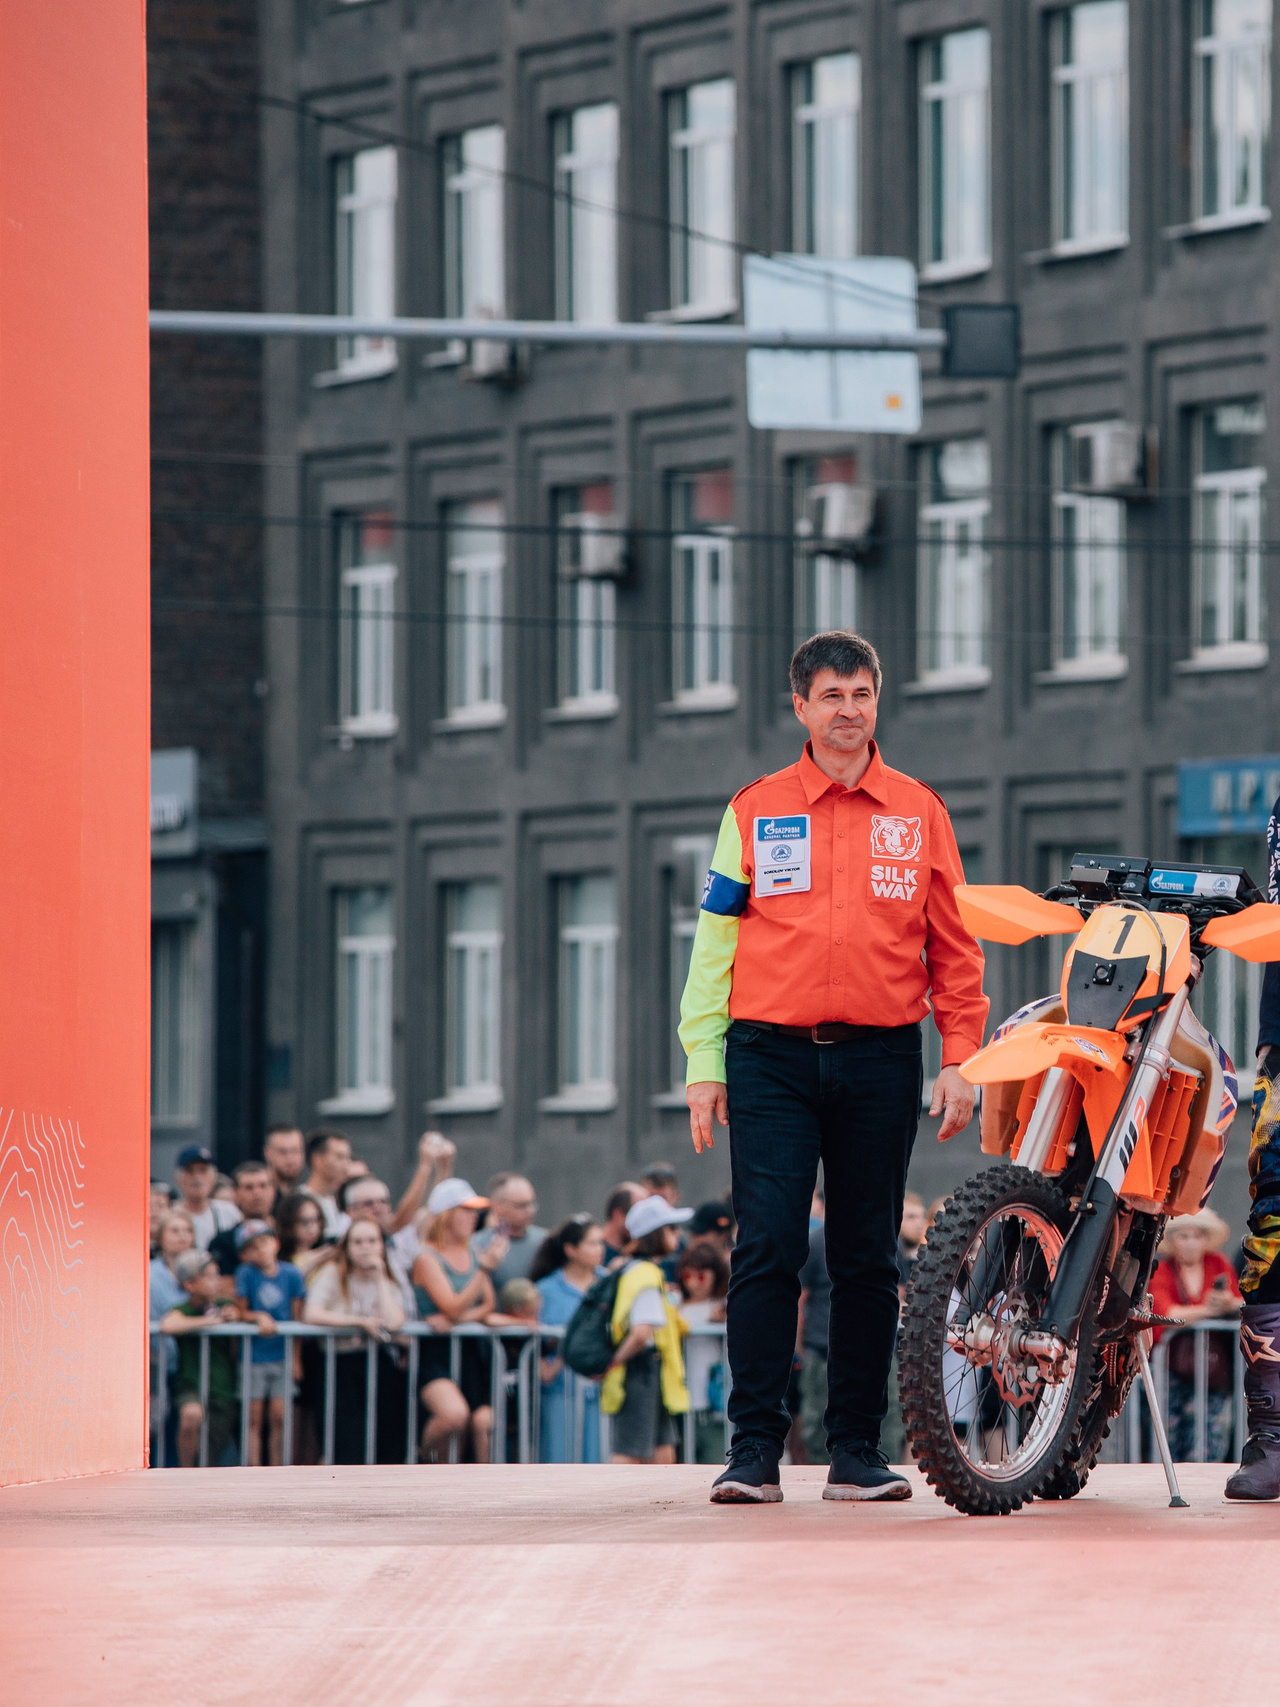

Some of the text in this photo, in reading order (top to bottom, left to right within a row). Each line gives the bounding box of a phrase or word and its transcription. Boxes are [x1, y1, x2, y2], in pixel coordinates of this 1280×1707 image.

[870, 864, 918, 886] SILK
[870, 880, 918, 901] WAY
[1112, 914, 1137, 955] 1
